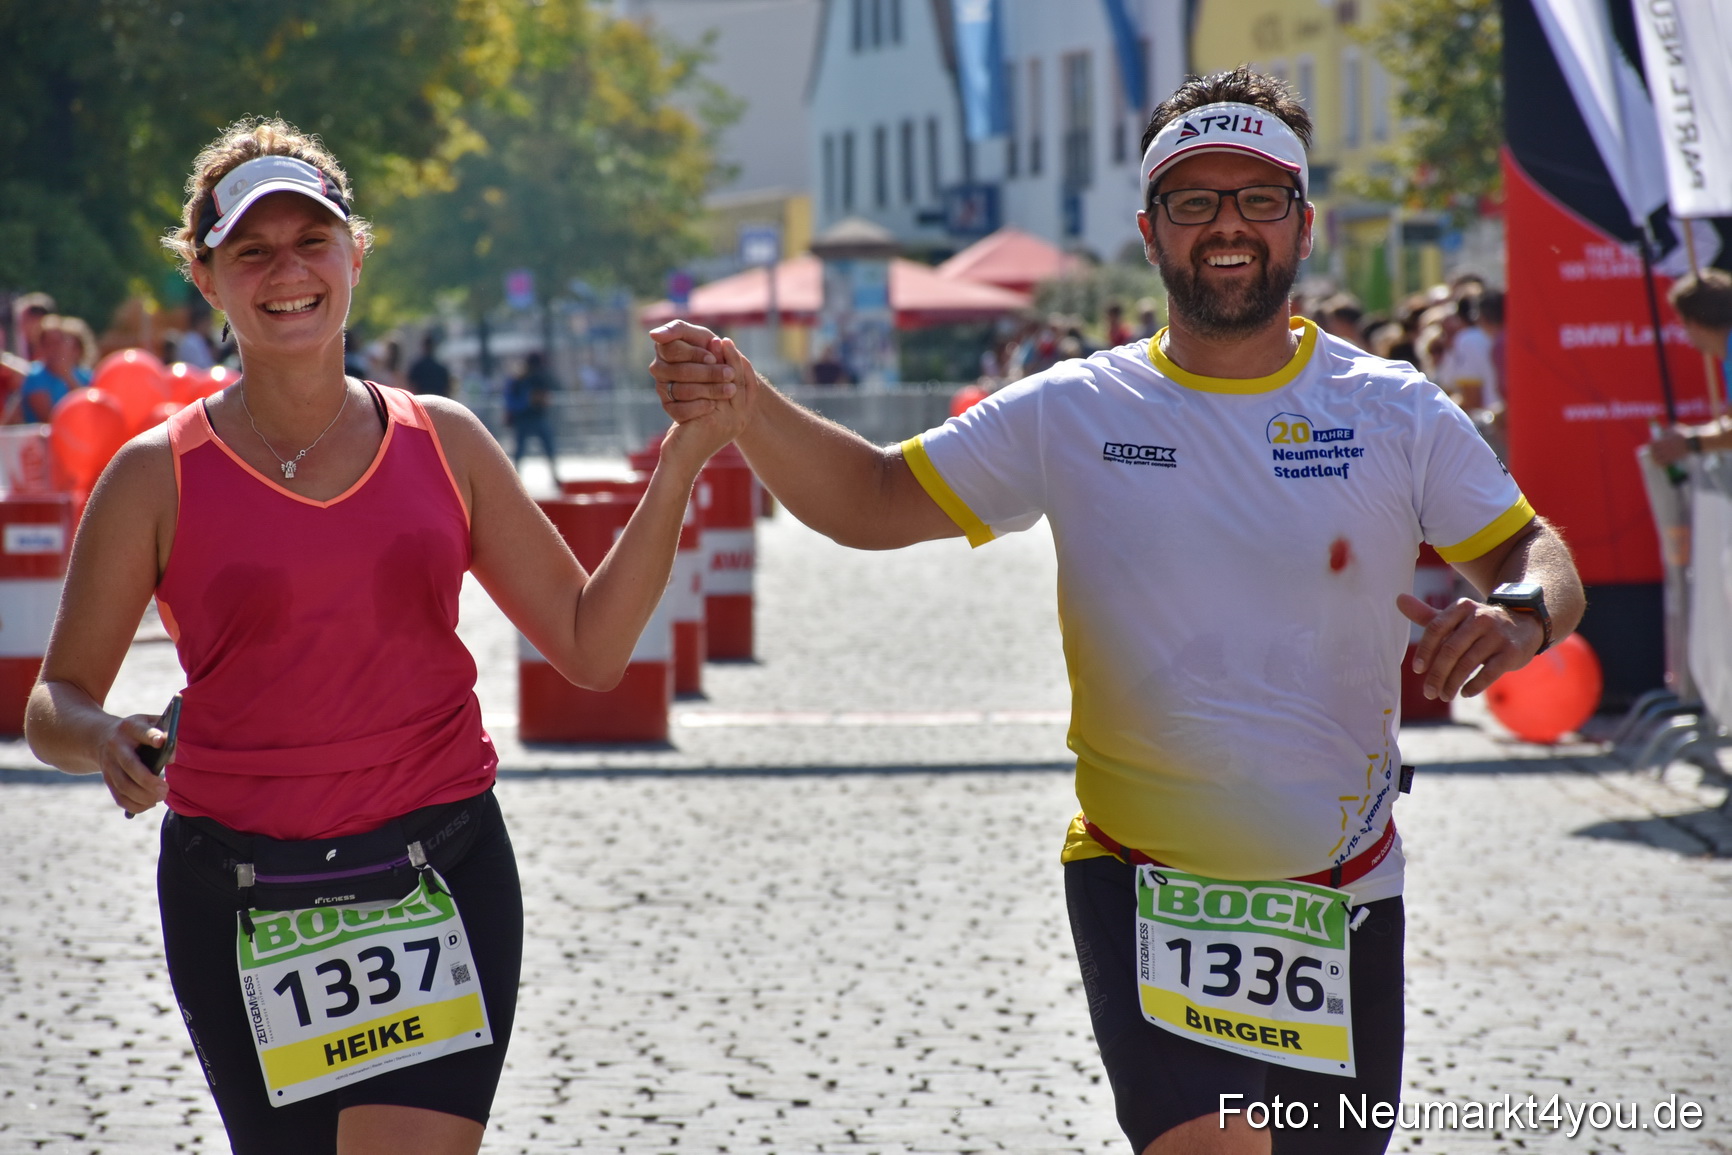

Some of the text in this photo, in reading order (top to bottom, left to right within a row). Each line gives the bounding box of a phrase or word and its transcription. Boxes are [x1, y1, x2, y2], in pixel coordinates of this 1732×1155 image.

[1200, 114, 1263, 136] TRI11
[1560, 324, 1620, 348] BMW
[1272, 421, 1351, 444] 20 JAHRE
[1103, 442, 1177, 463] BOCK
[1272, 445, 1365, 461] Neumarkter
[1274, 462, 1350, 479] Stadtlauf
[1156, 881, 1328, 937] BOCK
[272, 934, 459, 1028] 1337 D
[1165, 937, 1339, 1012] 1336 D
[1185, 1005, 1303, 1051] BIRGER
[323, 1016, 425, 1066] HEIKE
